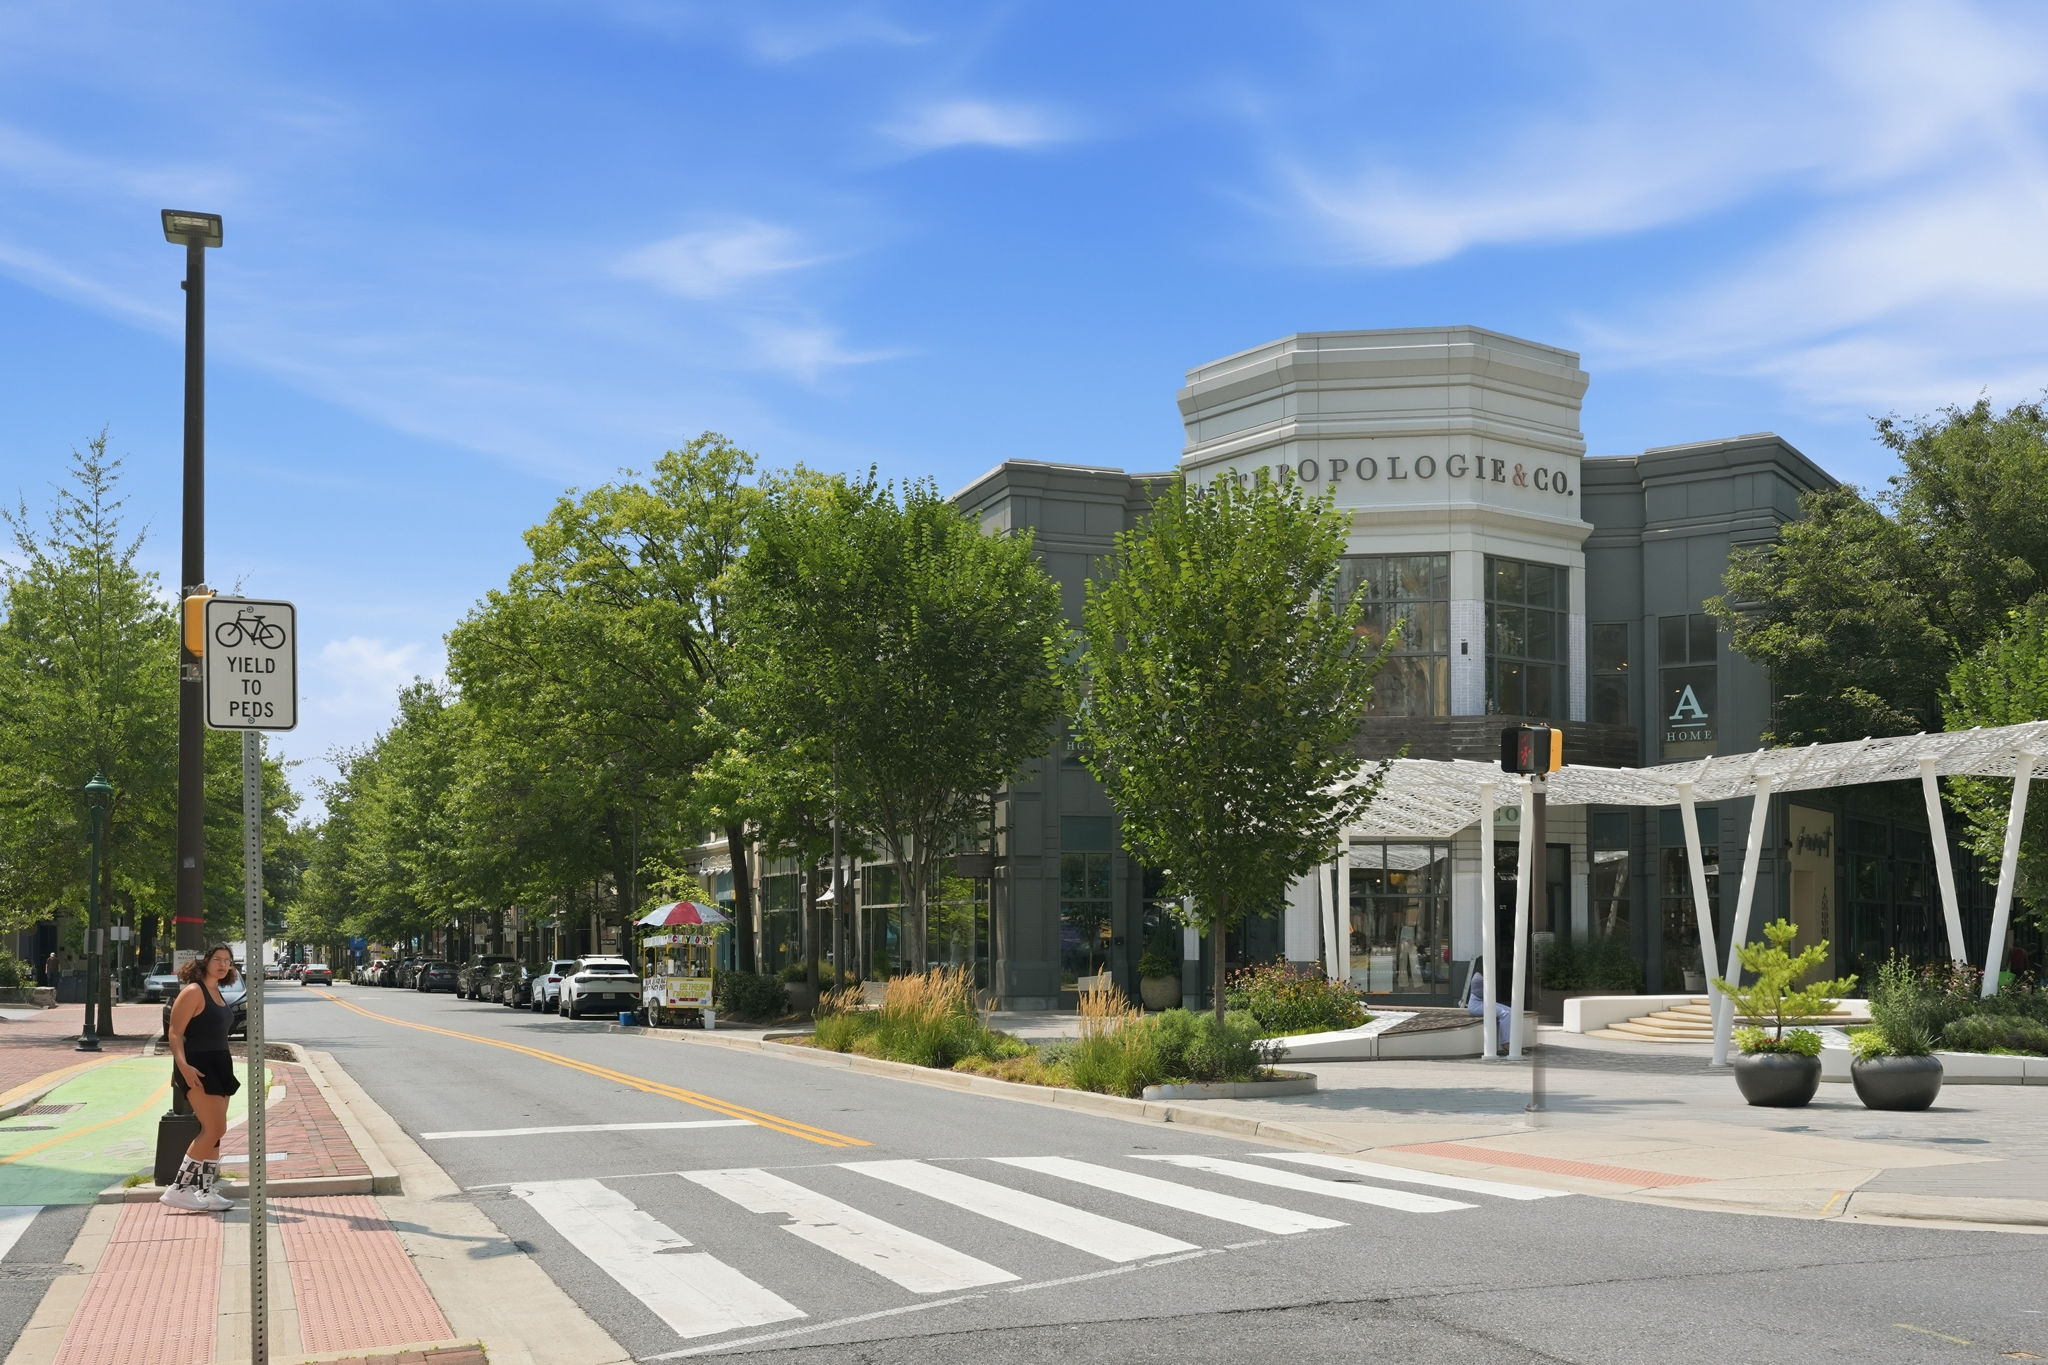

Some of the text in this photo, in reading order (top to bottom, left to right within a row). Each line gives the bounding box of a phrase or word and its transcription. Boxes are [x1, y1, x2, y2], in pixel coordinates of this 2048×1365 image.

[227, 656, 276, 674] YIELD
[242, 679, 262, 696] TO
[229, 701, 274, 718] PEDS
[1669, 684, 1709, 720] A
[1666, 730, 1712, 742] HOME
